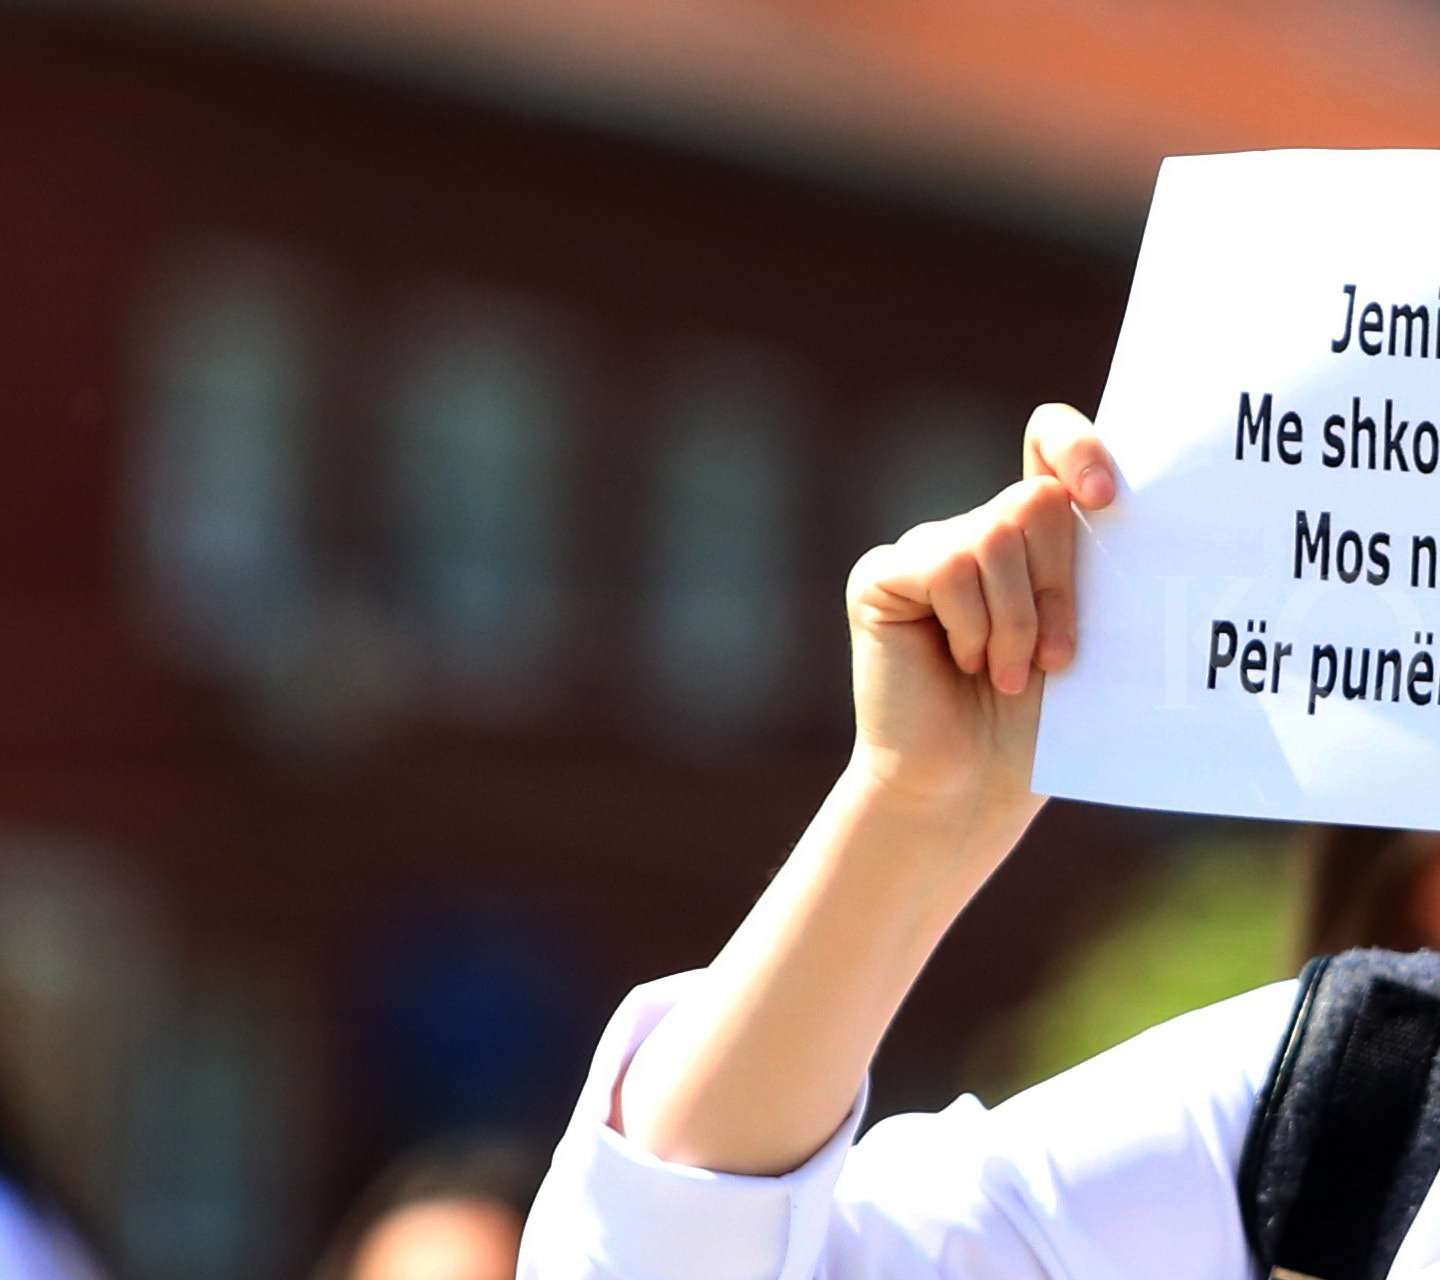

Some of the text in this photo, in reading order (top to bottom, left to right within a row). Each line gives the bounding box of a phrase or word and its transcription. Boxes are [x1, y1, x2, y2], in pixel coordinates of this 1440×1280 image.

[1234, 390, 1304, 467] Me
[1292, 508, 1392, 587] Mos
[1205, 618, 1294, 696] Për
